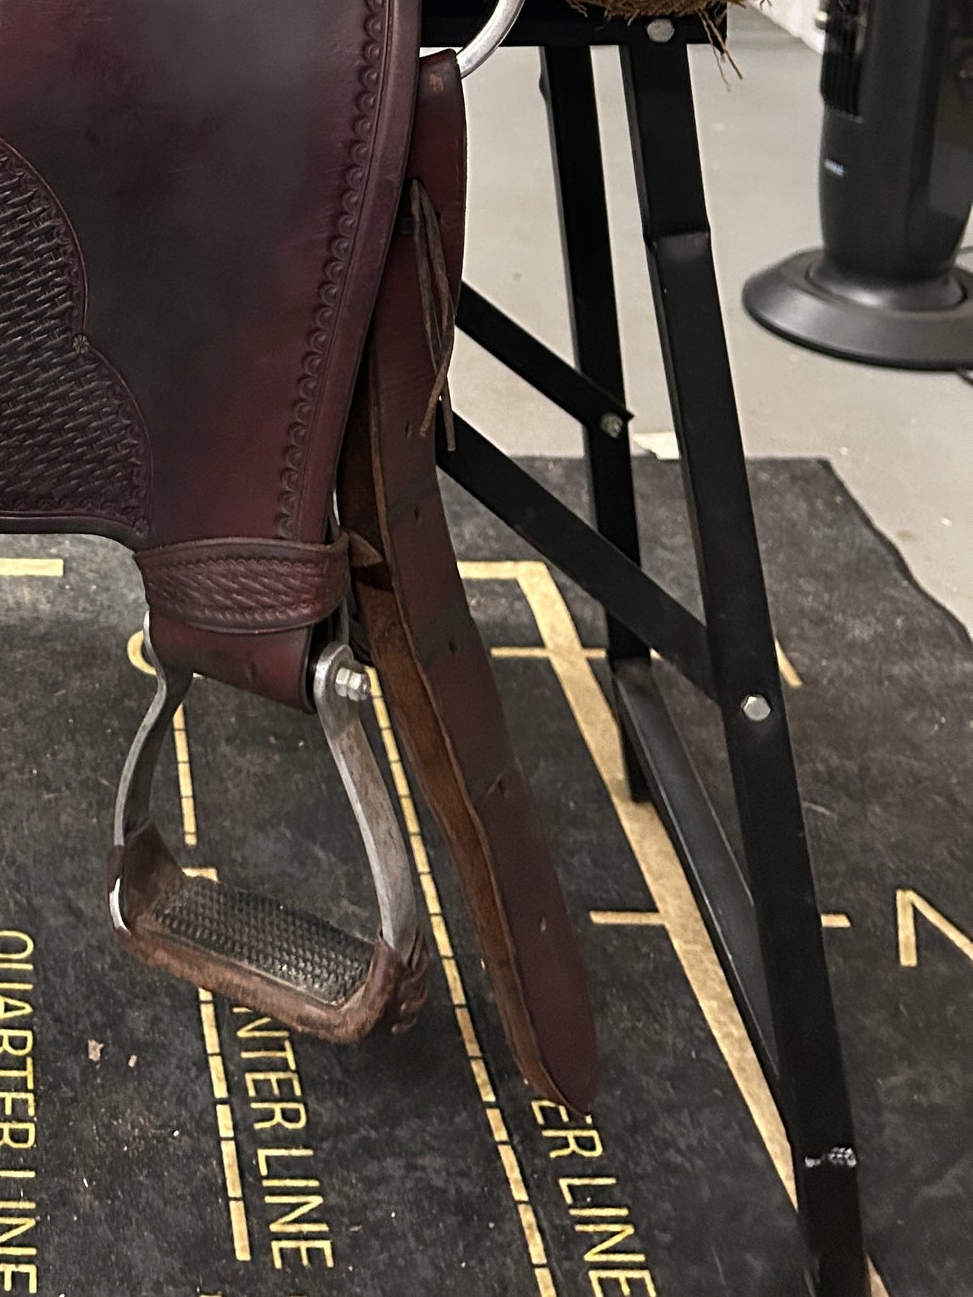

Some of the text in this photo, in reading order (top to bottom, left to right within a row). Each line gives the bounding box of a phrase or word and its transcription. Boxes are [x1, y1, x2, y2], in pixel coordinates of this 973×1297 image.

[232, 1006, 335, 1270] NTER LINE
[558, 1176, 657, 1297] LINE
